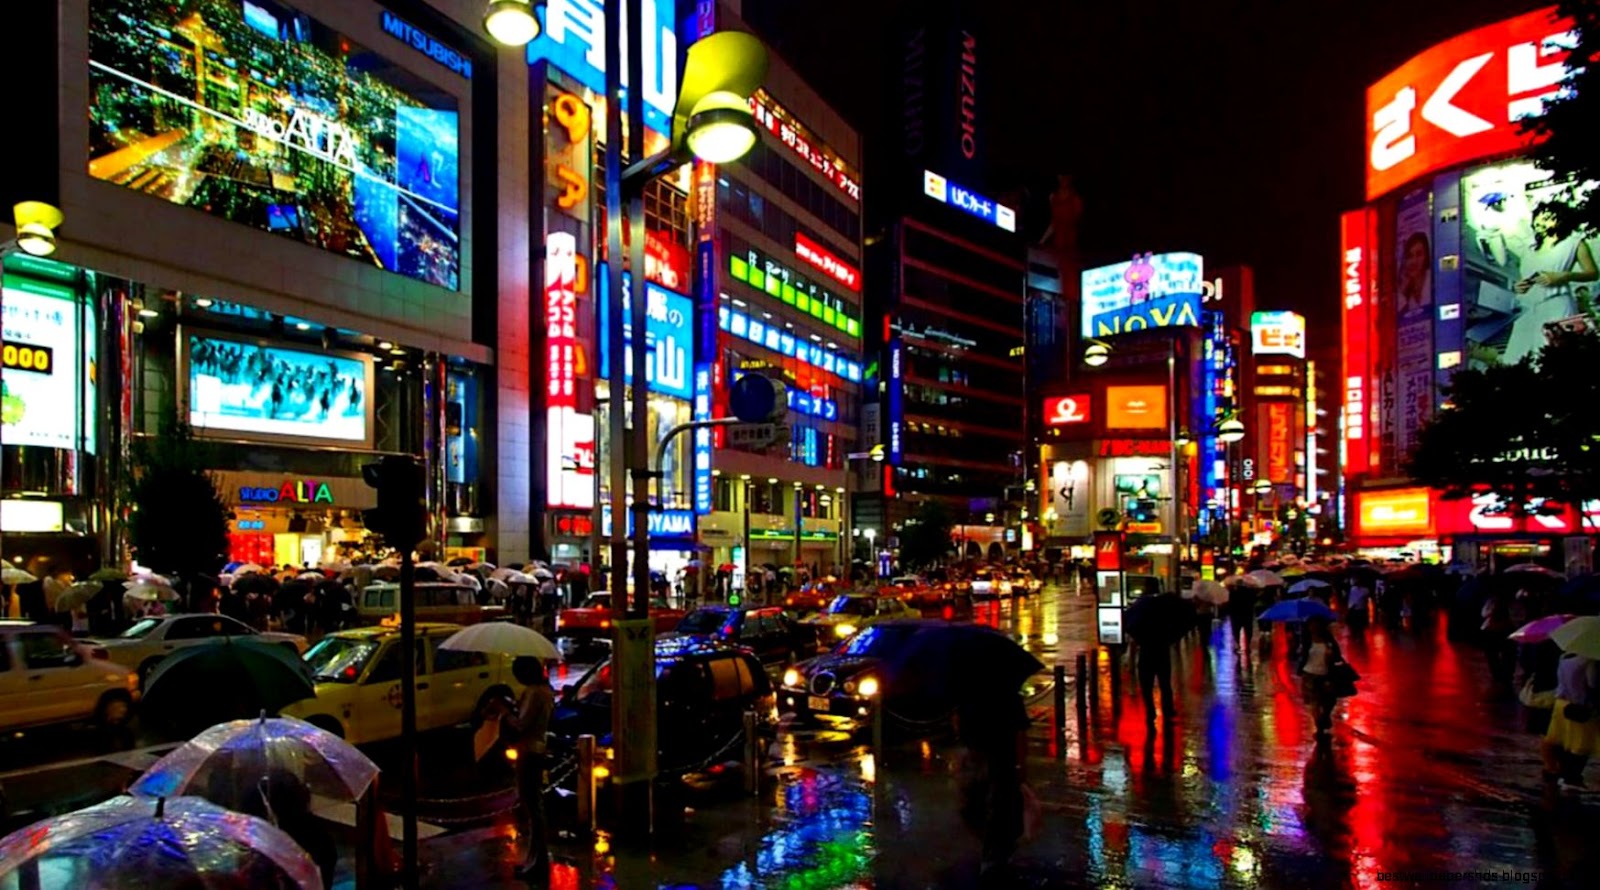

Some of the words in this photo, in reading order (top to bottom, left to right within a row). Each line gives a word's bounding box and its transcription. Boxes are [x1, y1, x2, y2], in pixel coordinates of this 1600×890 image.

[383, 11, 472, 79] MITSUBISHI
[960, 29, 976, 160] MIZUHO
[284, 107, 360, 169] ALTA
[951, 186, 992, 217] UCカード
[1098, 301, 1199, 337] NOVA
[3, 344, 49, 371] 000
[240, 487, 278, 502] STUDIO
[278, 480, 333, 503] ALTA
[1102, 510, 1115, 525] 2
